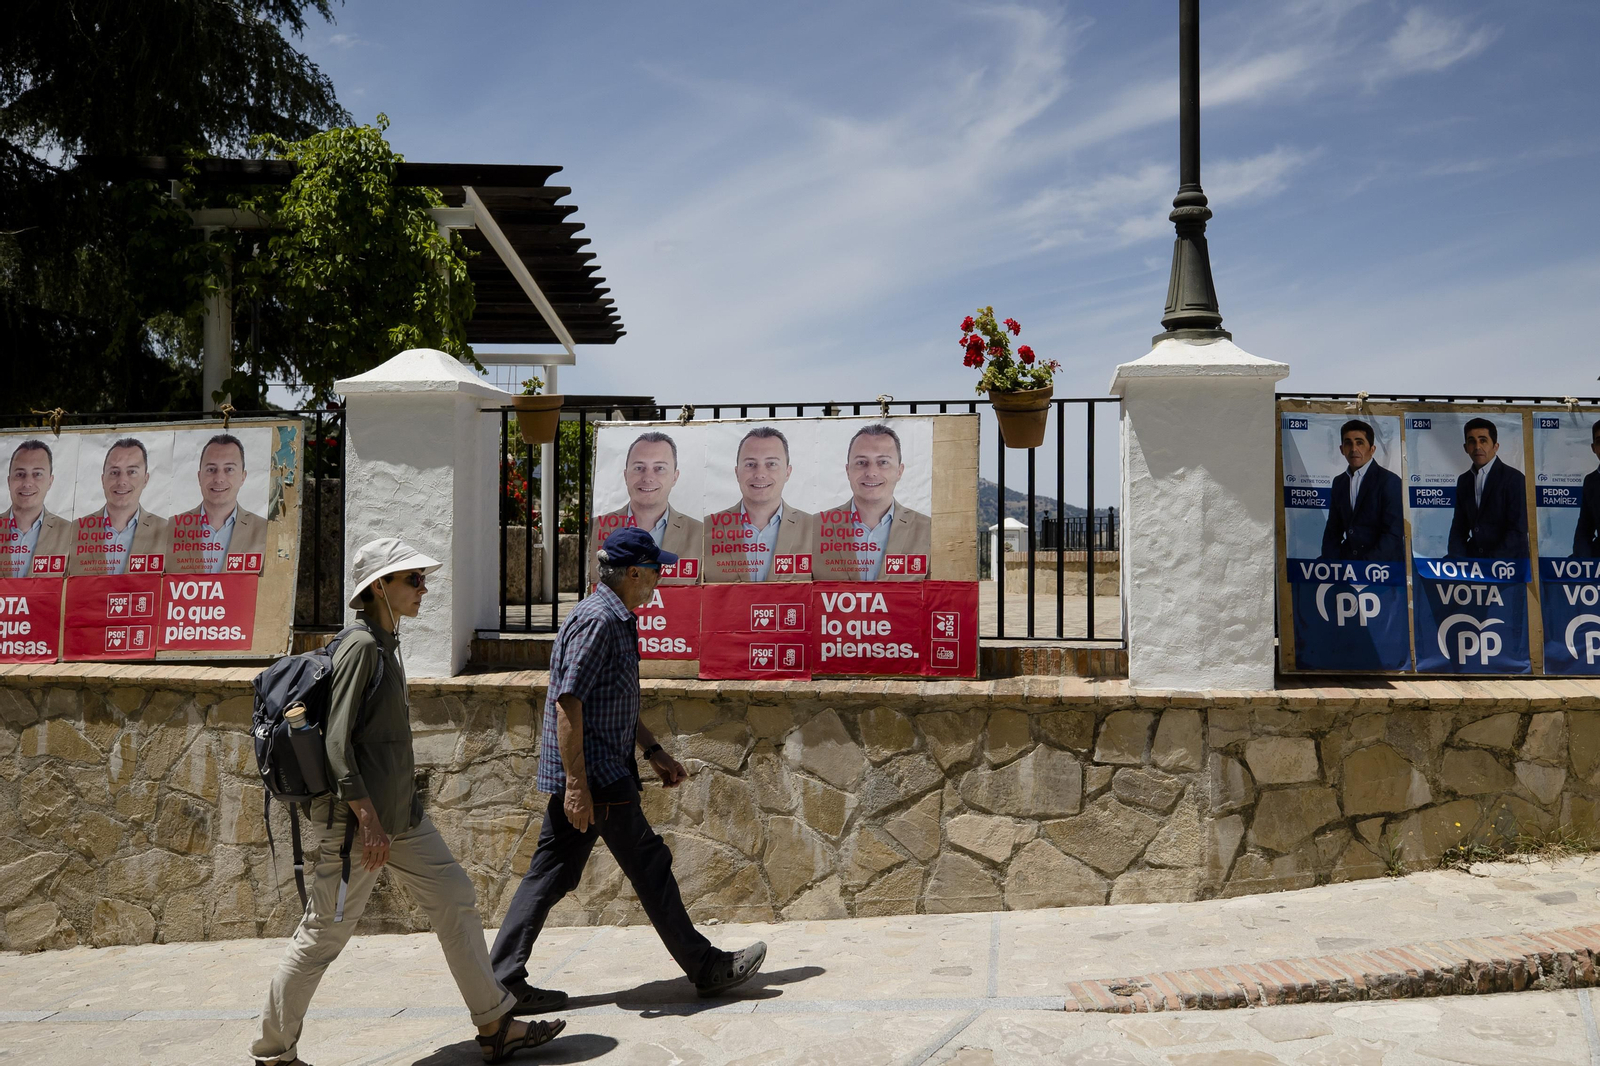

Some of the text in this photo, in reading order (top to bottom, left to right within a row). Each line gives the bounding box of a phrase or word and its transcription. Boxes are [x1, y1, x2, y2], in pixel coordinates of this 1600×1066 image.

[1292, 497, 1326, 506] RAMÍREZ
[1416, 496, 1451, 505] RAMÍREZ
[1543, 496, 1577, 505] RAMÍREZ
[0, 518, 18, 528] TA
[78, 517, 112, 528] VOTA
[174, 514, 210, 526] VOTA
[598, 515, 638, 527] VOTA
[711, 513, 752, 526] VOTA
[820, 511, 862, 524] VOTA
[78, 531, 113, 542] lo que
[174, 527, 211, 540] lo que
[711, 527, 753, 541] lo que
[820, 525, 864, 540] lo que
[0, 545, 30, 554] nsas.
[76, 542, 126, 555] piensas.
[173, 541, 224, 553] piensas.
[711, 542, 770, 556] piensas.
[820, 540, 881, 554] piensas.
[1300, 562, 1358, 581] VOTA
[1427, 561, 1484, 579] VOTA
[169, 582, 224, 600] VOTA
[1436, 584, 1504, 606] VOTA
[1563, 585, 1600, 606] VO
[821, 592, 888, 613] VOTA
[167, 602, 226, 623] lo que
[636, 616, 667, 630] ue
[821, 615, 891, 640] lo que
[945, 615, 954, 637] PSOE
[108, 631, 126, 639] PSOE
[165, 622, 246, 644] piensas.
[0, 641, 52, 654] nsas.
[638, 637, 692, 652] nsas.
[821, 637, 920, 661] piensas.
[752, 649, 773, 657] PSOE
